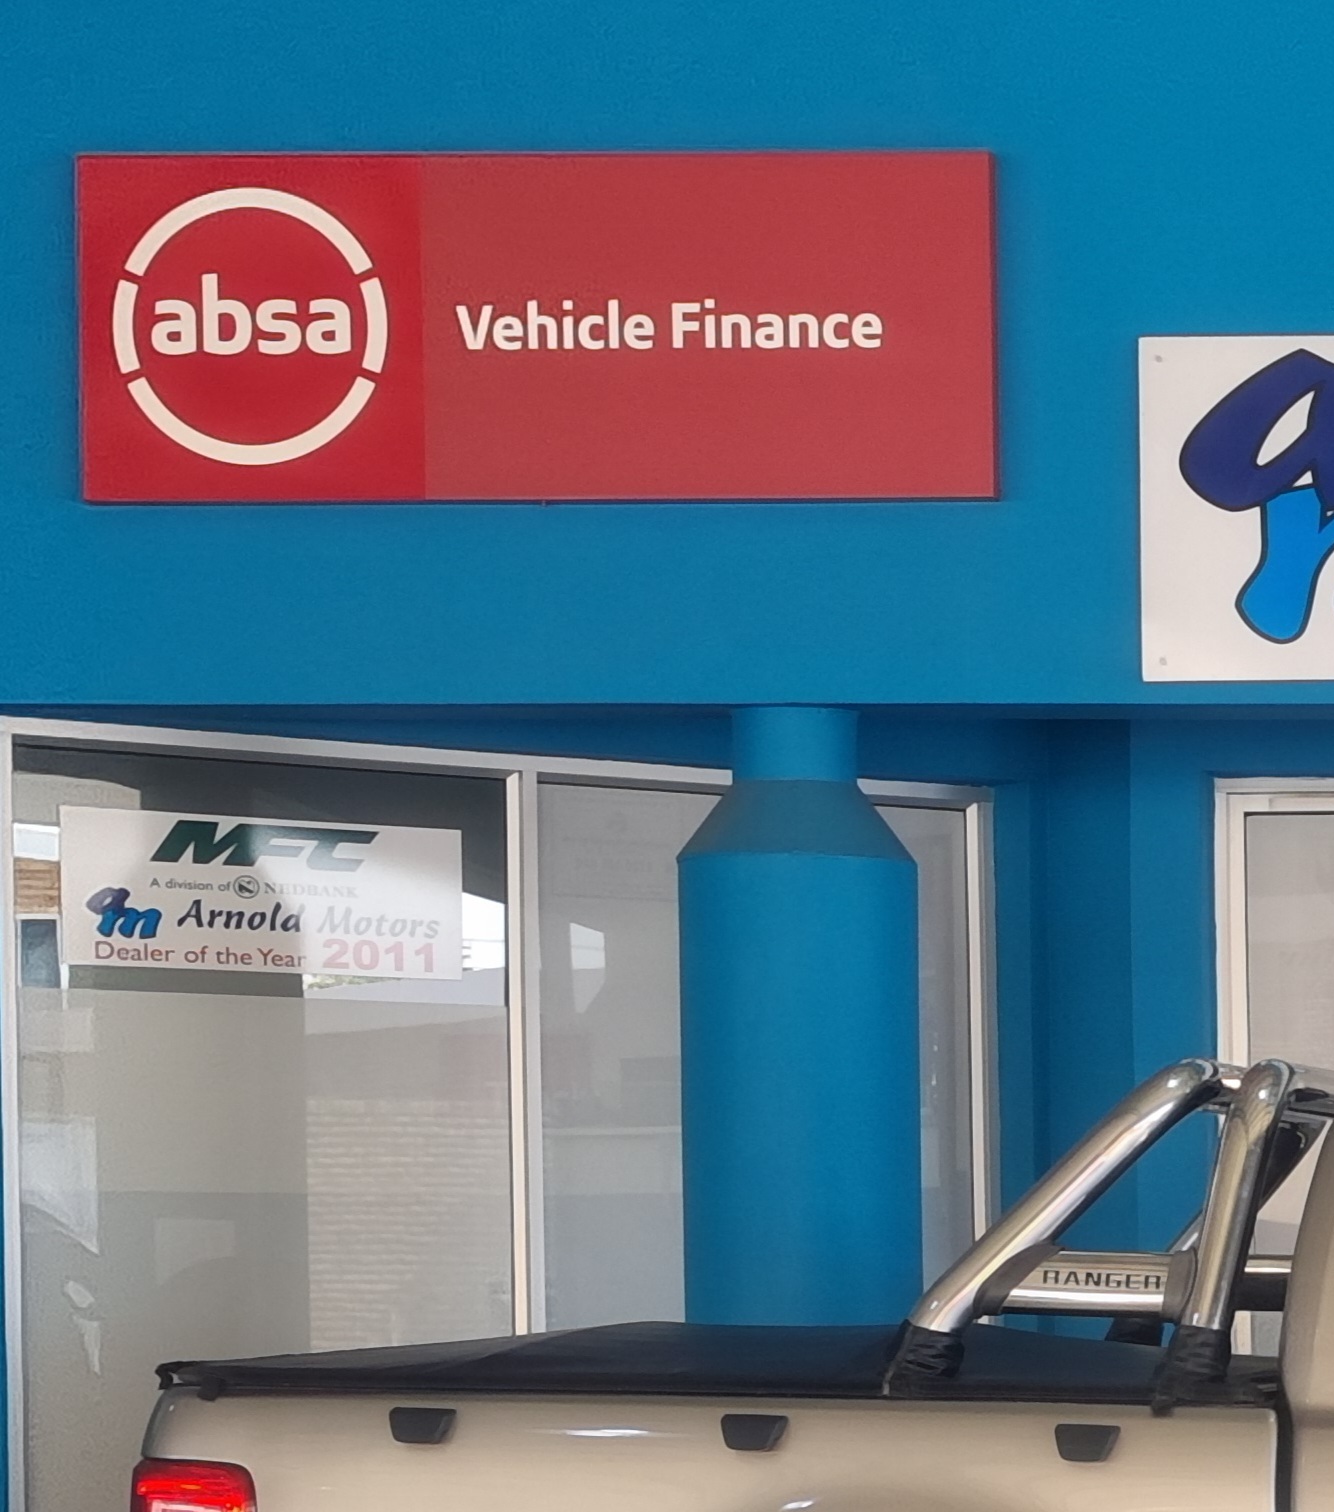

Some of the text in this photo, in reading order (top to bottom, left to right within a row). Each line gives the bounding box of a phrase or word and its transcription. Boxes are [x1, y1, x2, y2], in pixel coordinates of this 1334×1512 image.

[151, 274, 352, 355] absa
[456, 300, 883, 351] Vehicle Finance
[150, 877, 161, 890] A
[165, 877, 219, 893] division
[221, 878, 234, 892] of
[264, 881, 358, 899] NEDBANK
[177, 899, 302, 934] Arnold
[317, 903, 440, 939] Motors
[94, 939, 434, 973] Dealer of the Year 2011
[1042, 1269, 1162, 1291] RANGER
